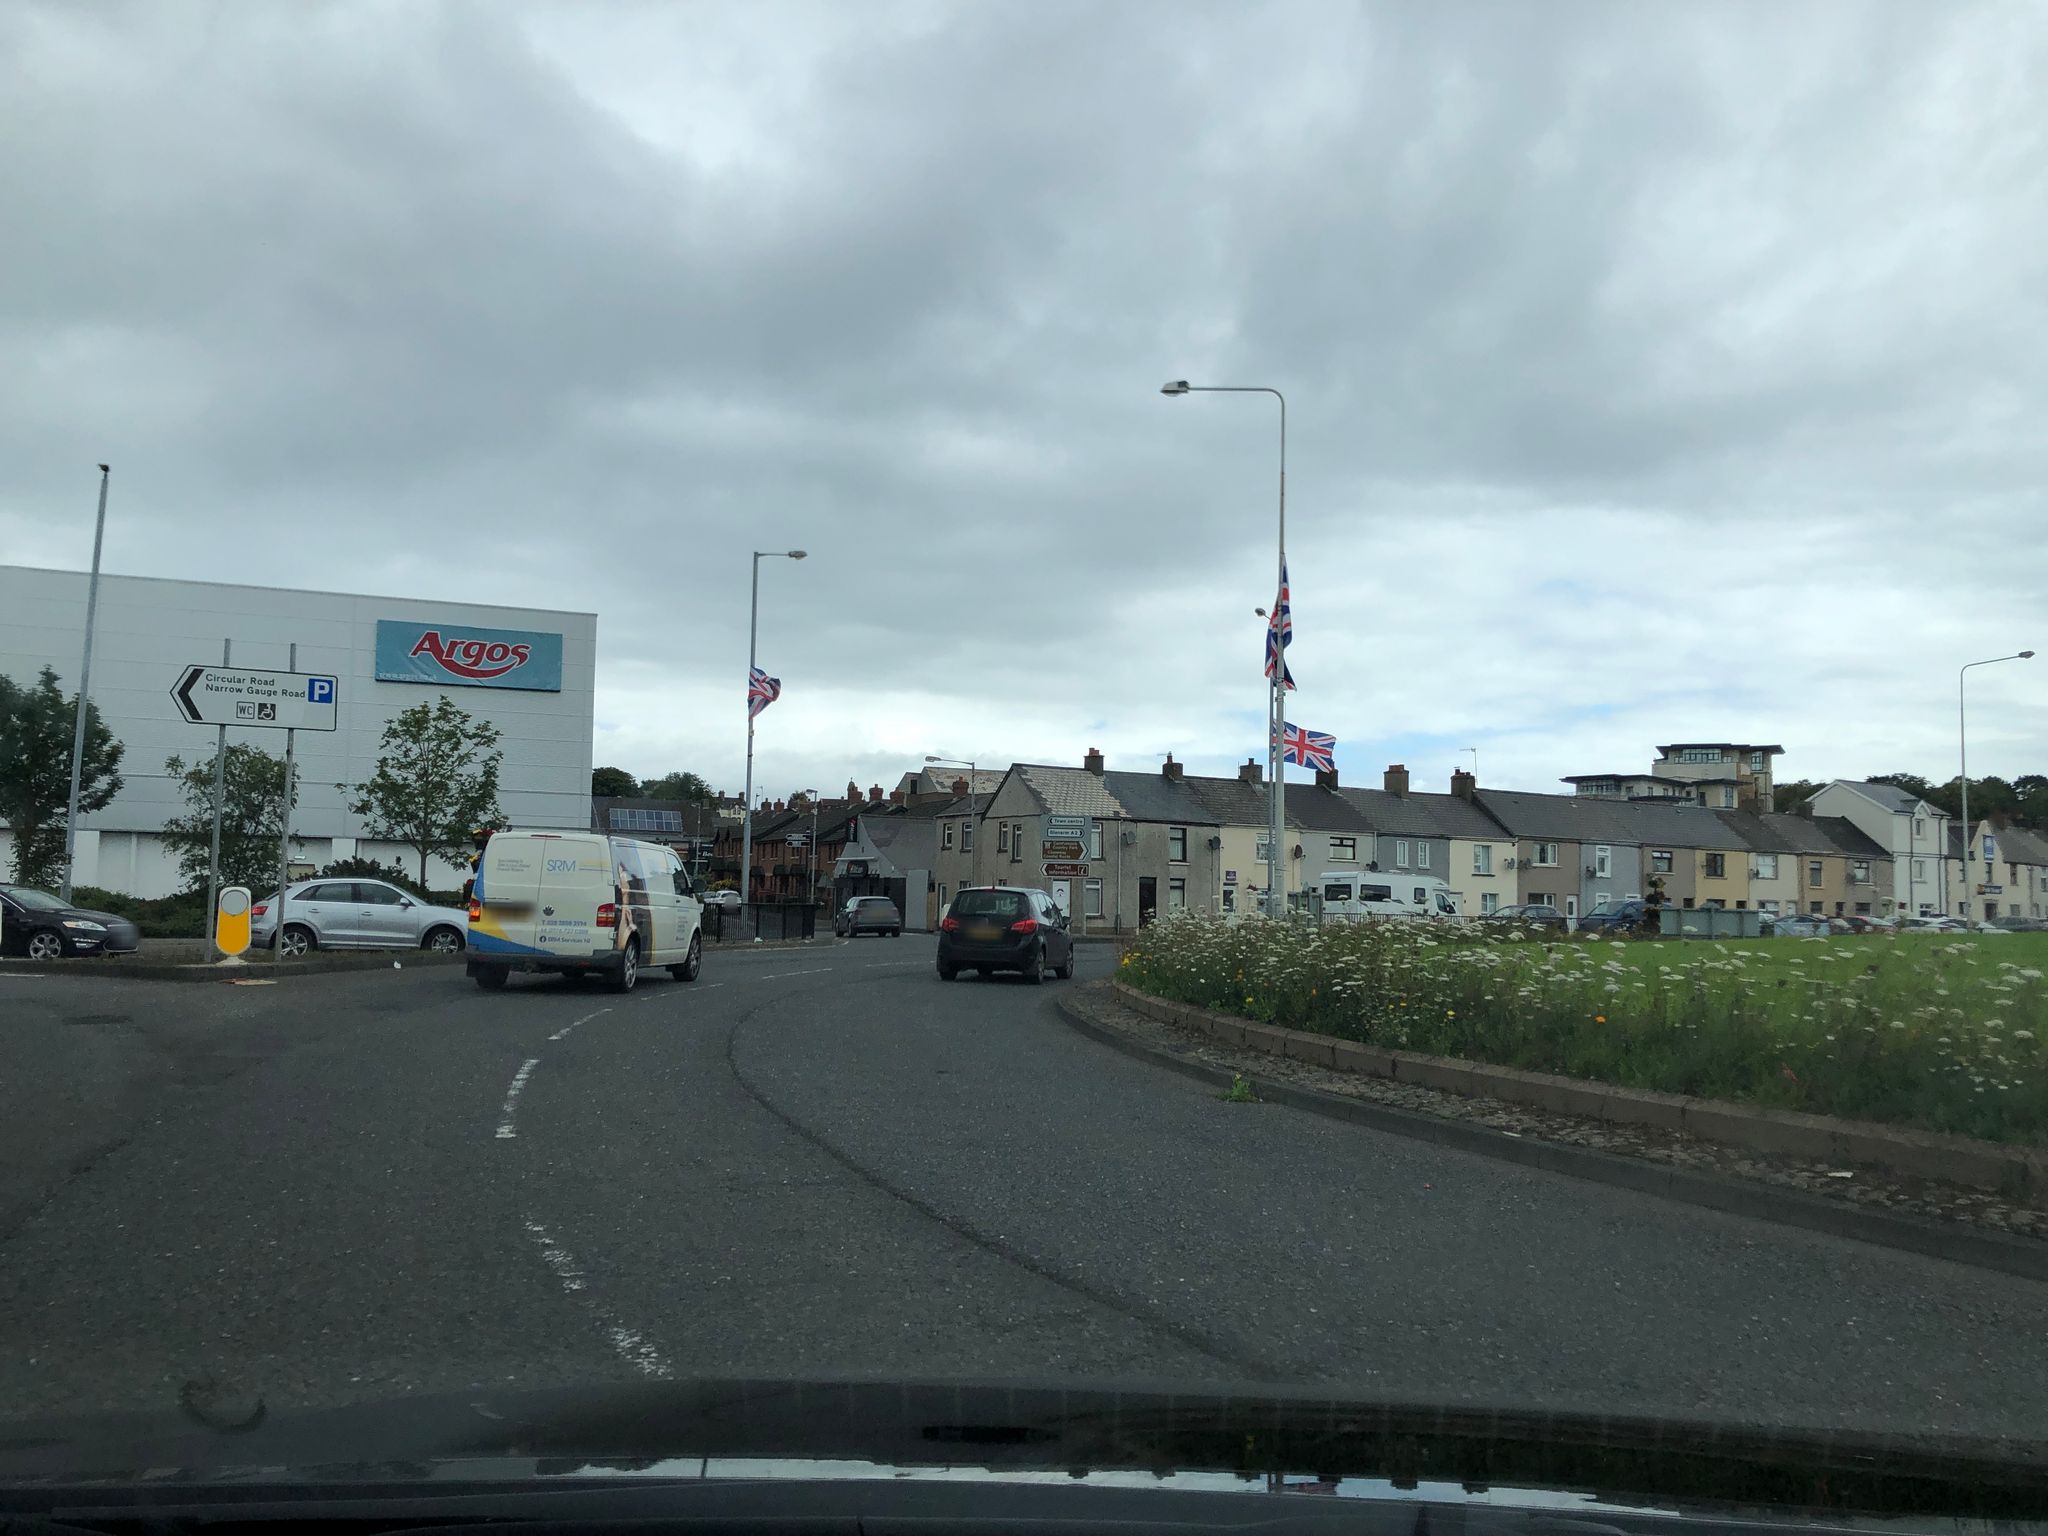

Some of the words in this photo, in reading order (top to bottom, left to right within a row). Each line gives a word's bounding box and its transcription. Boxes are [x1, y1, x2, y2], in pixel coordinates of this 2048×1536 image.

[409, 630, 532, 679] Argos
[205, 673, 246, 685] Circular
[250, 677, 275, 687] Road
[205, 683, 243, 694] Narrow
[246, 686, 278, 698] Gauge
[281, 689, 306, 698] Road
[314, 681, 330, 701] P
[238, 704, 254, 716] WC
[546, 859, 576, 872] SRM
